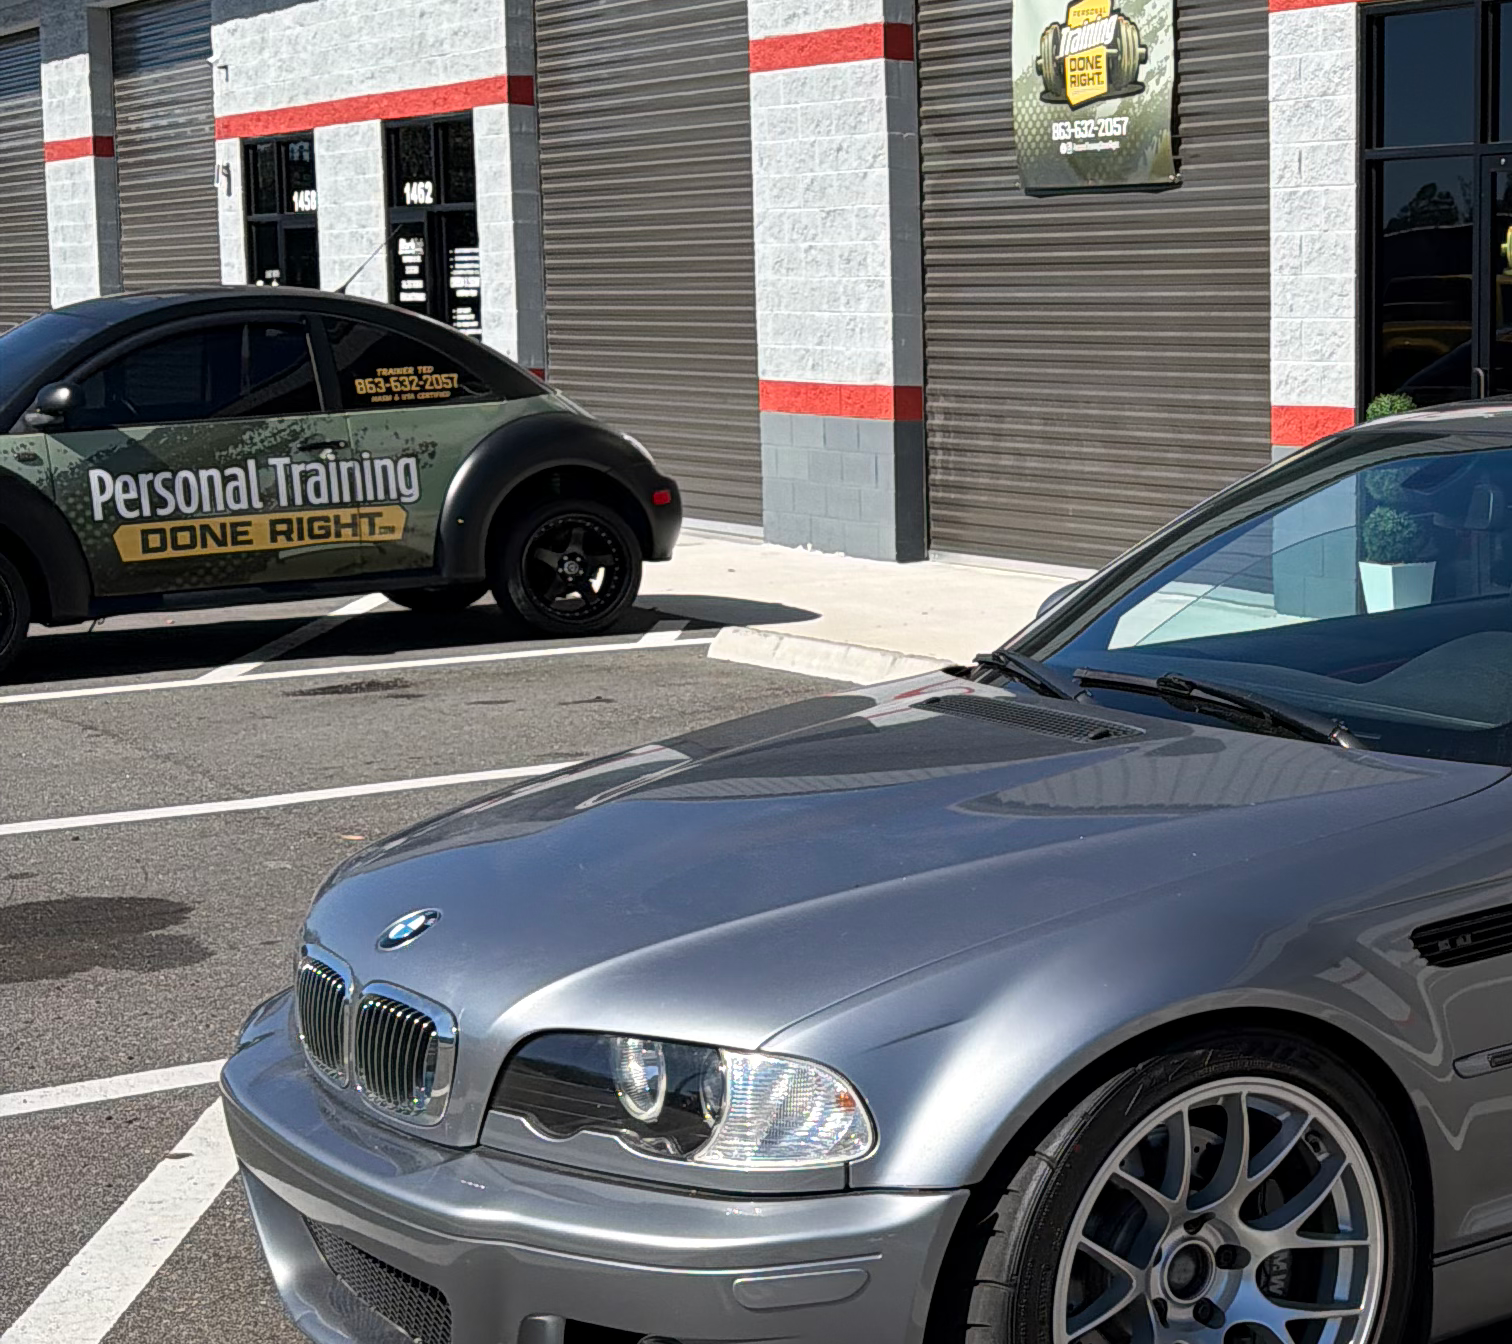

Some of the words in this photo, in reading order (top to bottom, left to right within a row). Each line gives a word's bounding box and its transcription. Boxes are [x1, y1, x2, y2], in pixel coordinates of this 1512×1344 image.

[1060, 14, 1118, 58] Training
[1069, 54, 1102, 72] DONE
[1052, 116, 1129, 141] 863-632-2057
[404, 181, 434, 205] 1462
[354, 373, 459, 395] 863-632-2057
[88, 458, 264, 521] Personal
[268, 451, 420, 507] Training
[139, 520, 254, 555] DONE
